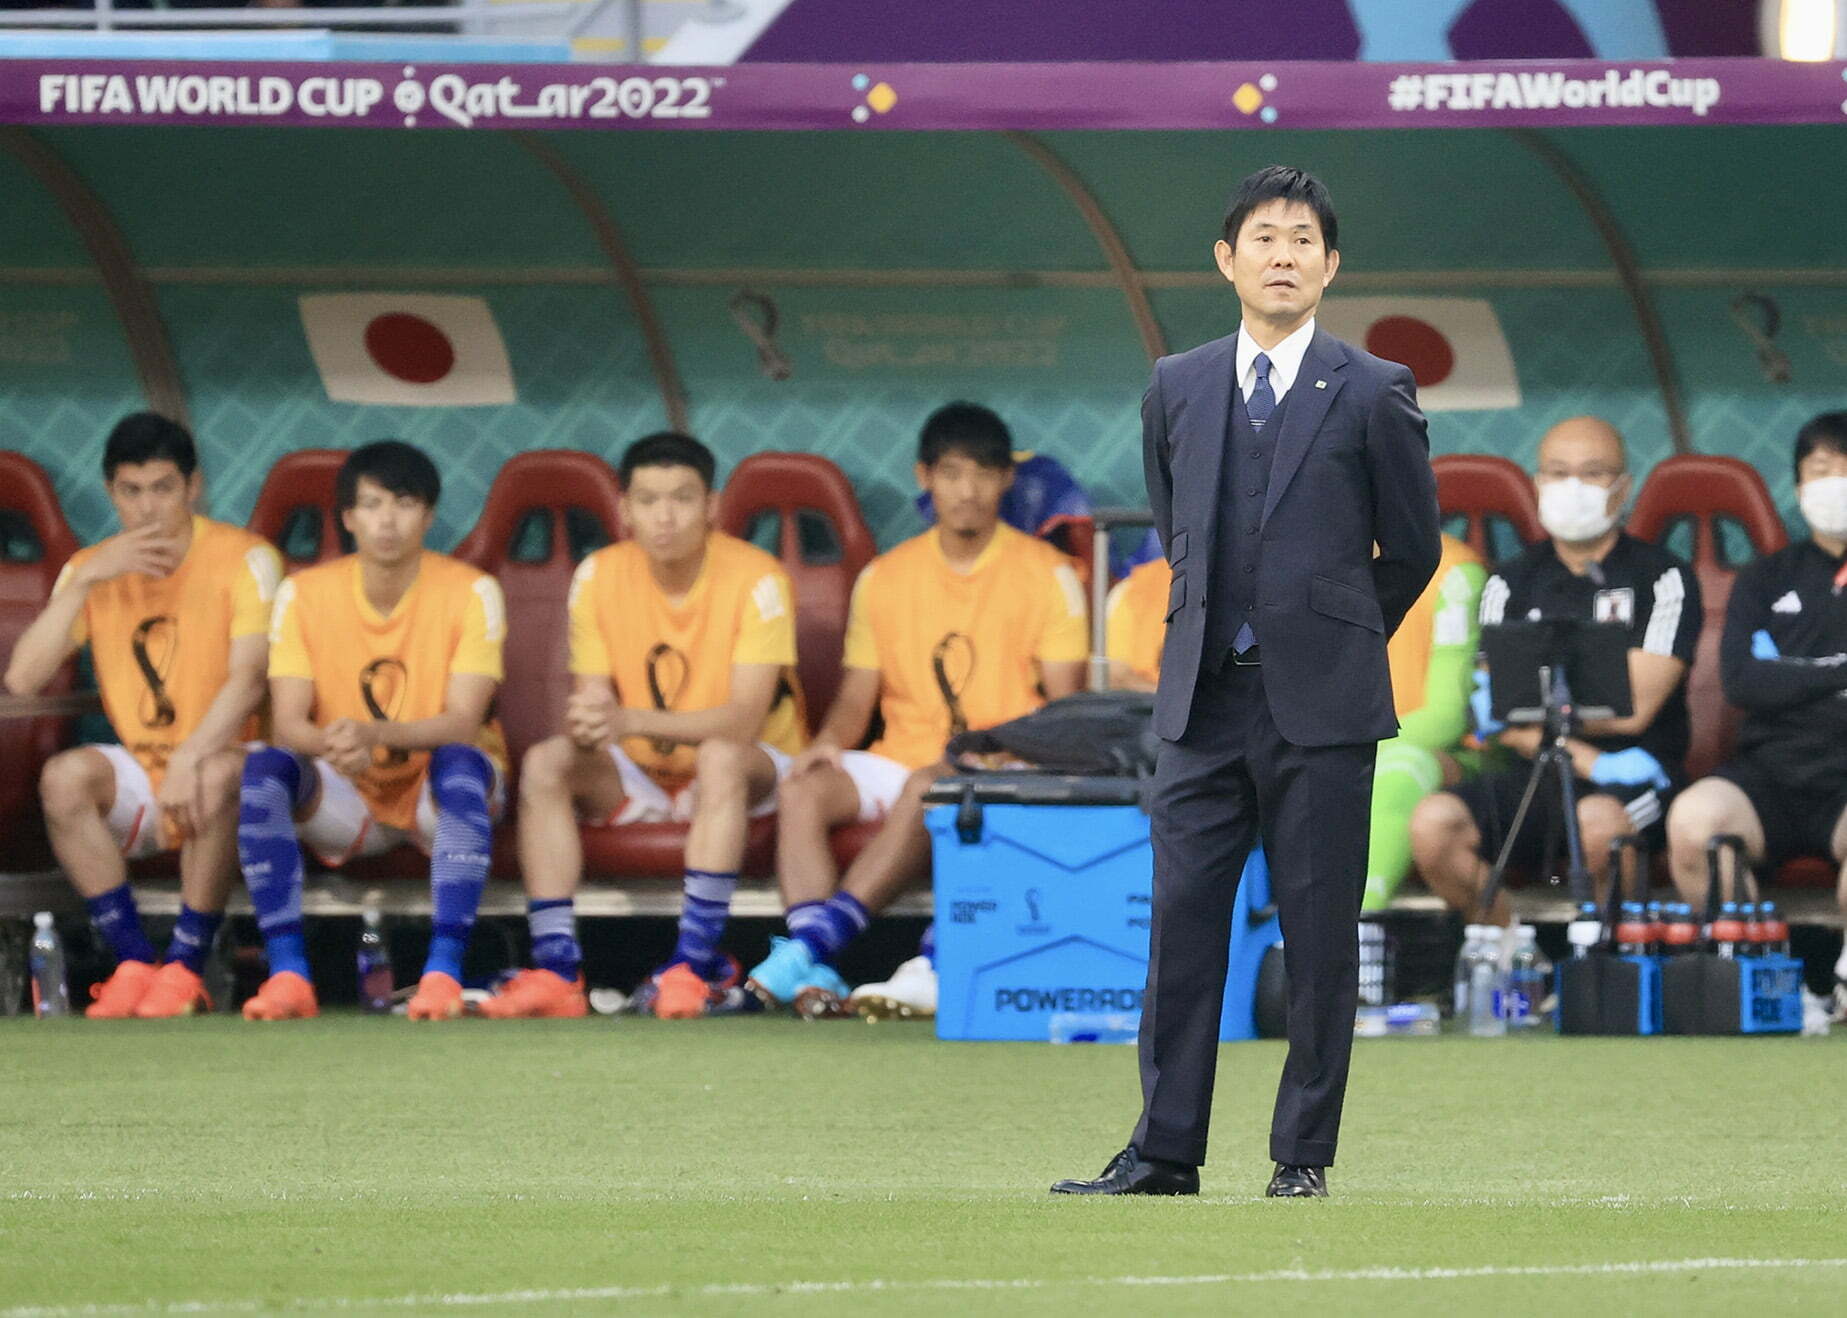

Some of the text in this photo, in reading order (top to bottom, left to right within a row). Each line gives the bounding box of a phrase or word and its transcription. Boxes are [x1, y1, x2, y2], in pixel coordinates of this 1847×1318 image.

[39, 74, 135, 114] FIFA
[135, 75, 294, 116] WORLD
[297, 77, 383, 117] CUP
[1388, 69, 1720, 116] #FIFAWorldCup
[995, 987, 1145, 1012] POWERAD
